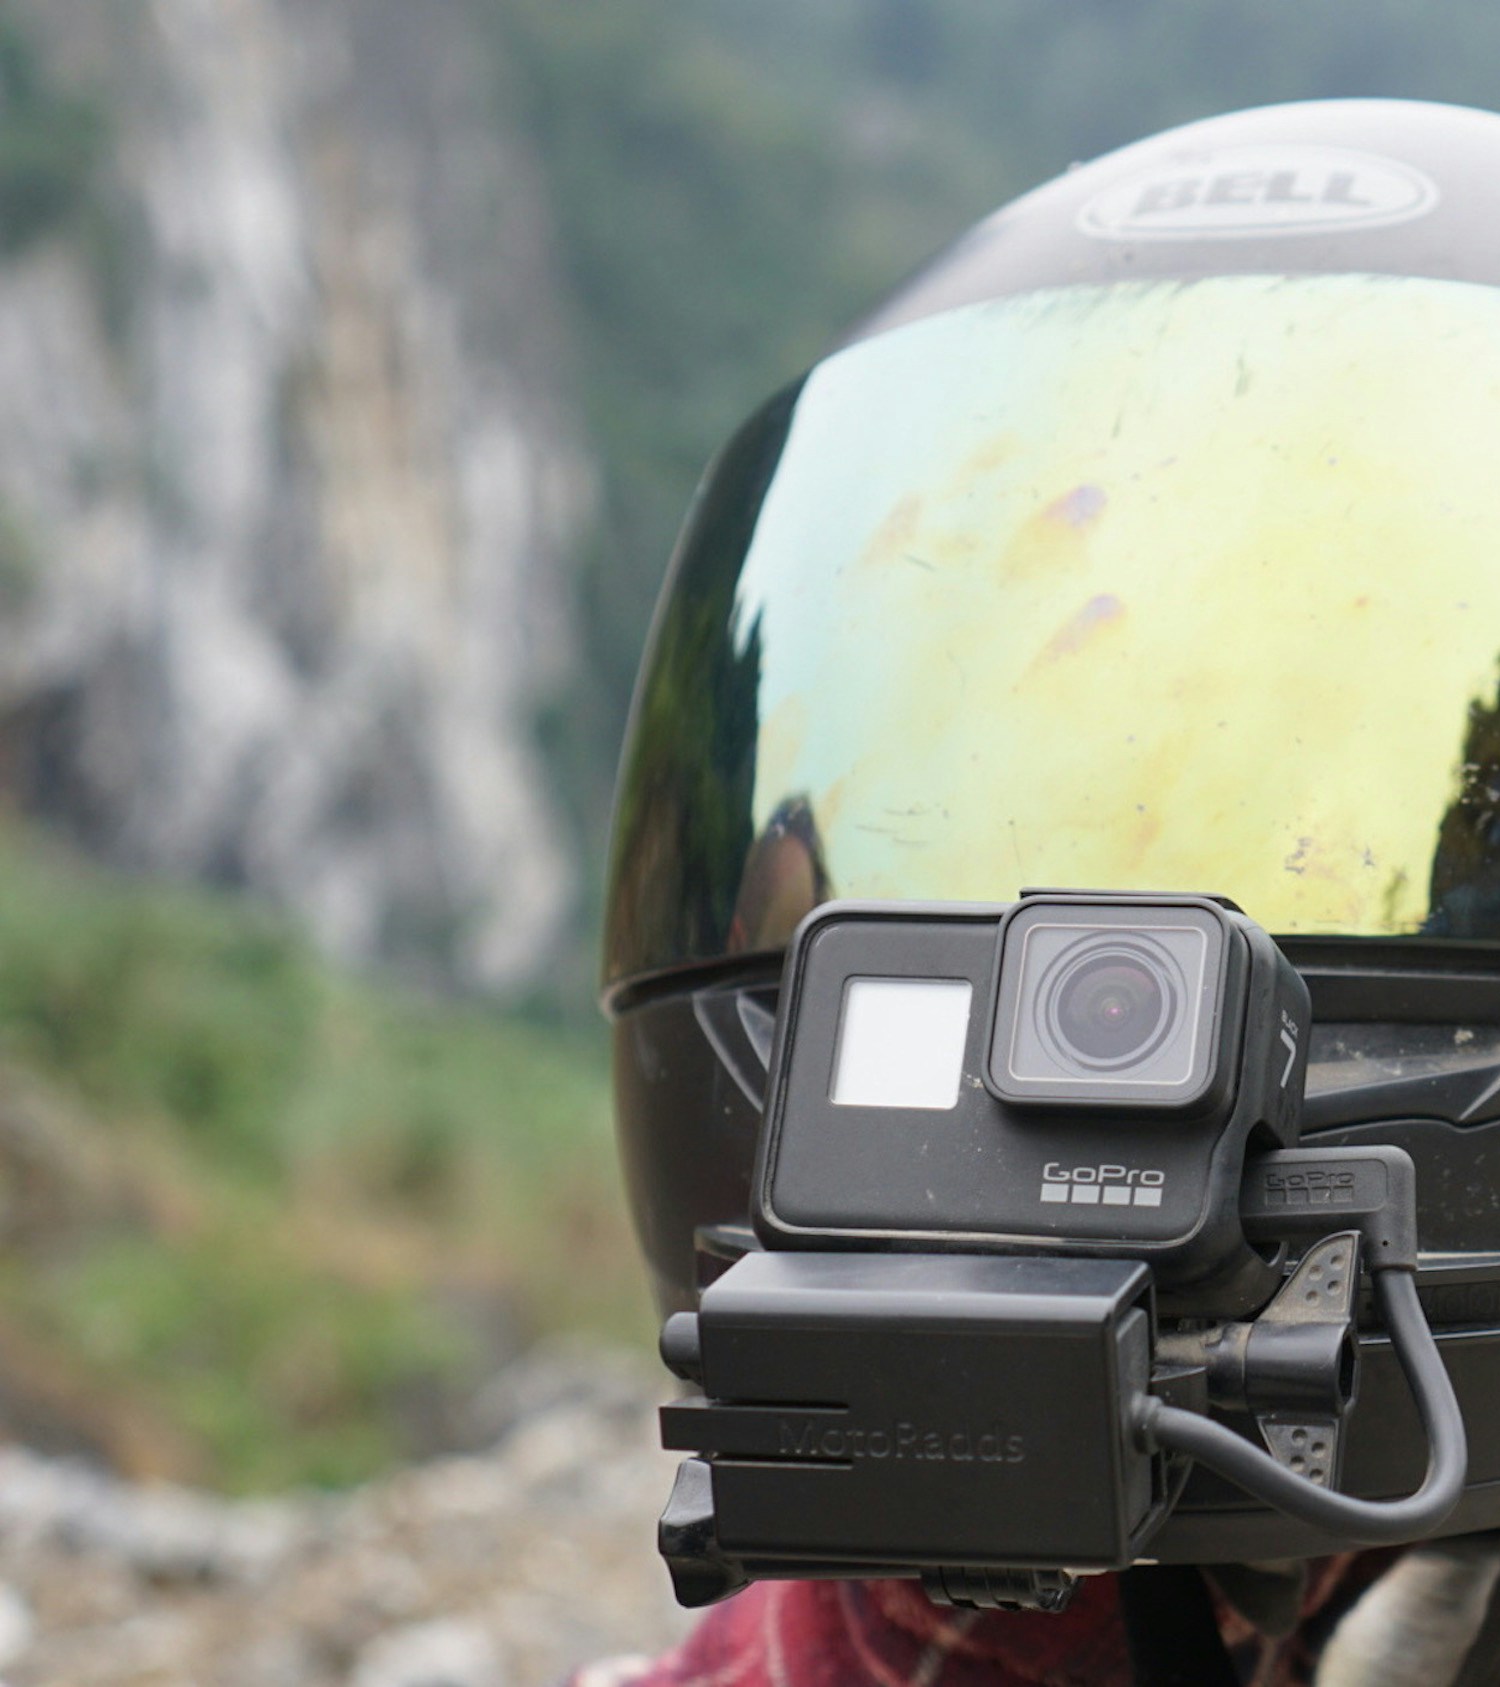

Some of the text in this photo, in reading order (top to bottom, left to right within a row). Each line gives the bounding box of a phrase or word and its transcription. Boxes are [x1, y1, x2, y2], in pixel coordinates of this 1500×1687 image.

[1131, 169, 1372, 216] BELL
[1280, 1028, 1297, 1089] 7
[1042, 1161, 1165, 1186] GoPro
[1265, 1170, 1356, 1188] GoPro
[778, 1419, 1027, 1463] MotoRadds
